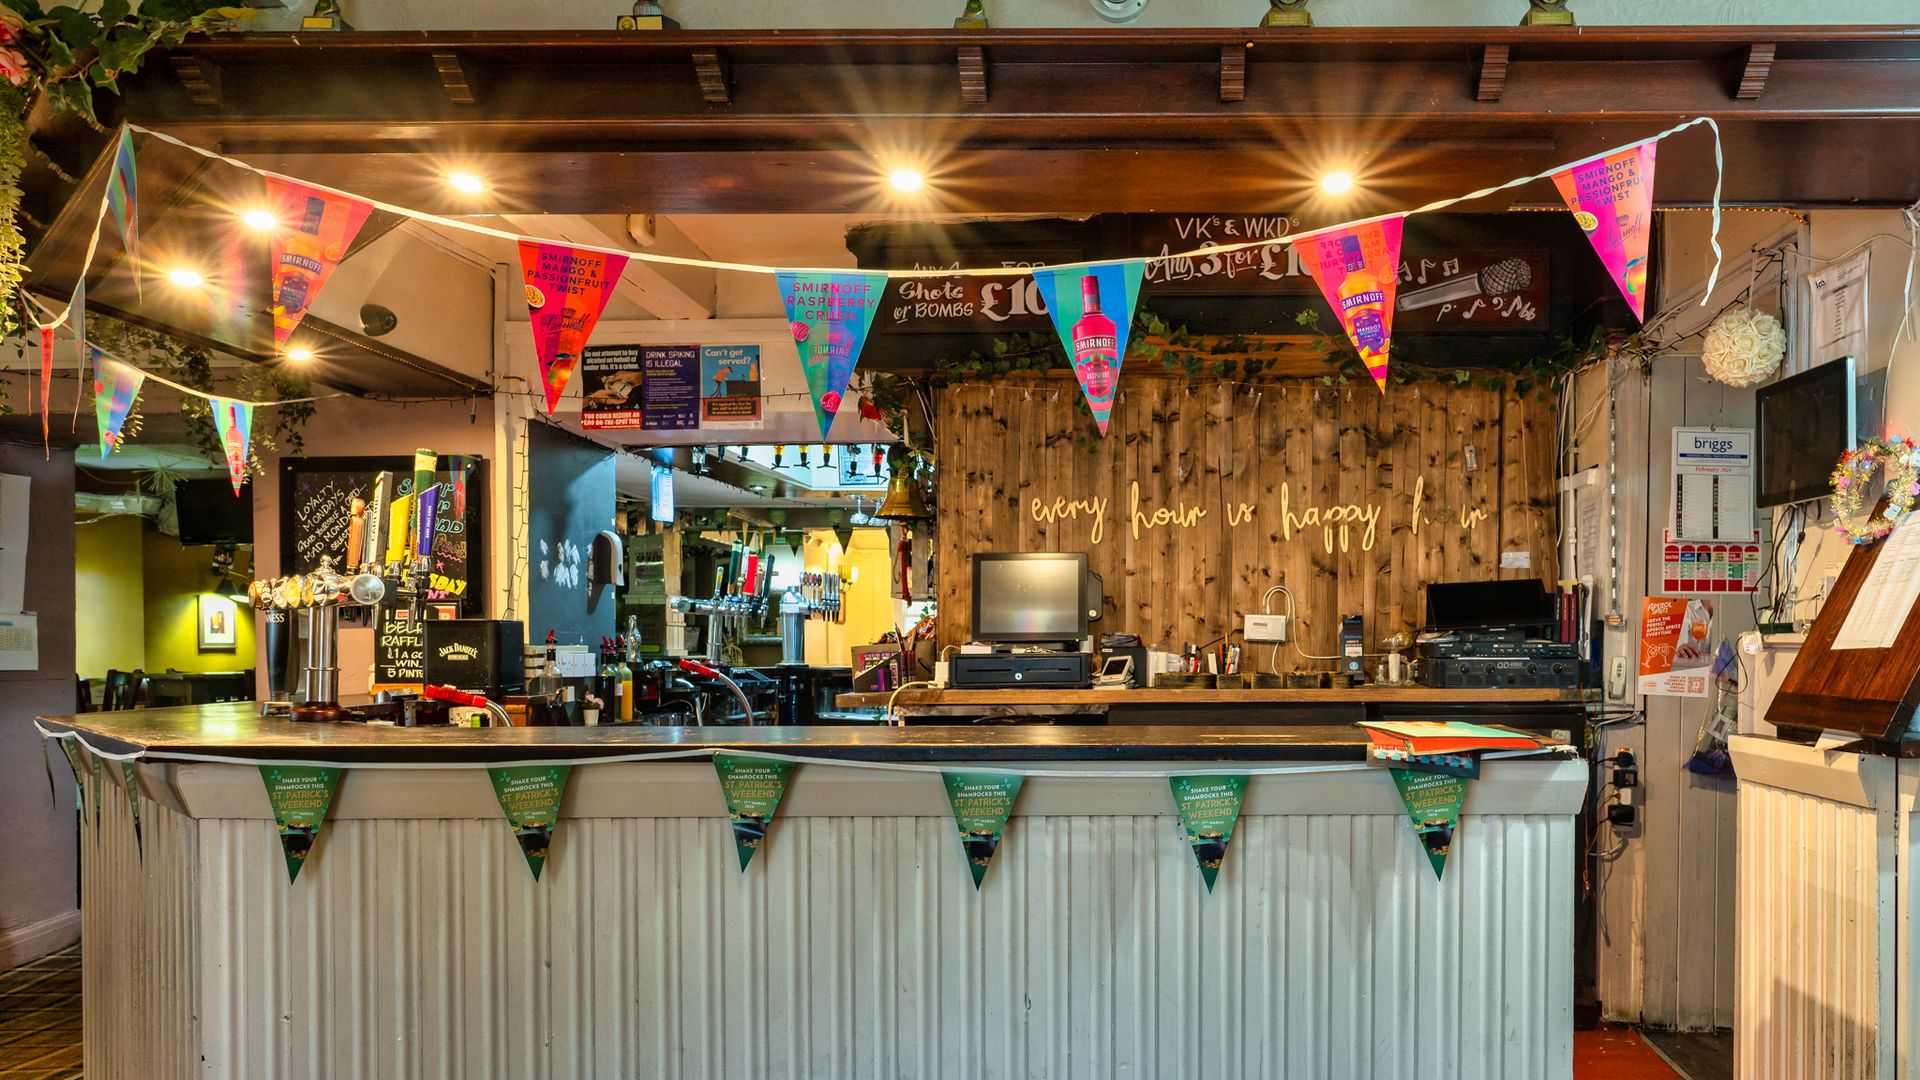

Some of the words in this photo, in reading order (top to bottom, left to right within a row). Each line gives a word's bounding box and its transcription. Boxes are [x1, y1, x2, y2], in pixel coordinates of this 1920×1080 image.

[1578, 158, 1636, 182] SMIRNOFF
[1582, 172, 1624, 190] MANGO
[1628, 168, 1634, 176] &
[1596, 190, 1630, 207] TWIST
[1175, 215, 1220, 239] VK's
[1224, 219, 1240, 236] &
[1244, 217, 1300, 238] WKD's
[280, 253, 322, 274] SMIRNOFF
[541, 252, 602, 268] SMIRNOFF
[1199, 241, 1222, 275] 3
[542, 262, 586, 276] MANGO
[590, 270, 597, 278] &
[528, 270, 610, 290] PASSIONFRUIT
[550, 284, 586, 296] TWIST
[792, 282, 871, 294] SMIRNOFF
[899, 281, 964, 300] Shots
[786, 295, 876, 308] RASPBERRY
[1342, 292, 1383, 310] SMIRNOFF
[805, 310, 856, 321] CRUSH
[894, 304, 912, 323] or
[915, 302, 974, 318] BOMBS
[1076, 338, 1115, 351] SMIRNOFF
[730, 349, 743, 358] get
[646, 360, 652, 368] IS
[655, 360, 682, 368] ILLEGAL
[718, 357, 751, 365] served?
[1694, 436, 1733, 452] briggs
[297, 480, 335, 521] LOYALTY
[303, 488, 344, 532] MONDAYS
[1031, 496, 1108, 544] every
[1131, 480, 1207, 540] hour
[1227, 502, 1255, 526] is
[1281, 482, 1382, 554] happy
[304, 542, 324, 563] MAD
[1648, 602, 1672, 611] APEROL
[1646, 630, 1672, 638] EVERYTIME
[402, 650, 408, 659] A
[396, 660, 419, 668] WIN
[388, 668, 396, 678] 5
[504, 784, 539, 793] SHAMROCKS
[740, 781, 782, 789] PATRICK'S
[1408, 781, 1442, 791] SHAMROCKS
[286, 790, 329, 799] PATRICK'S
[502, 794, 512, 802] ST
[516, 788, 559, 801] PATRICK'S
[731, 790, 776, 798] WEEKEND
[1406, 791, 1416, 800] ST
[1419, 784, 1462, 798] PATRICK'S
[279, 800, 323, 809] WEEKEND
[509, 799, 553, 811] WEEKEND
[968, 798, 1011, 806] PATRICK'S
[1182, 803, 1191, 811] ST
[1196, 798, 1238, 809] PATRICK'S
[1413, 795, 1456, 808] WEEKEND
[961, 808, 1004, 816] WEEKEND
[1188, 809, 1232, 819] WEEKEND
